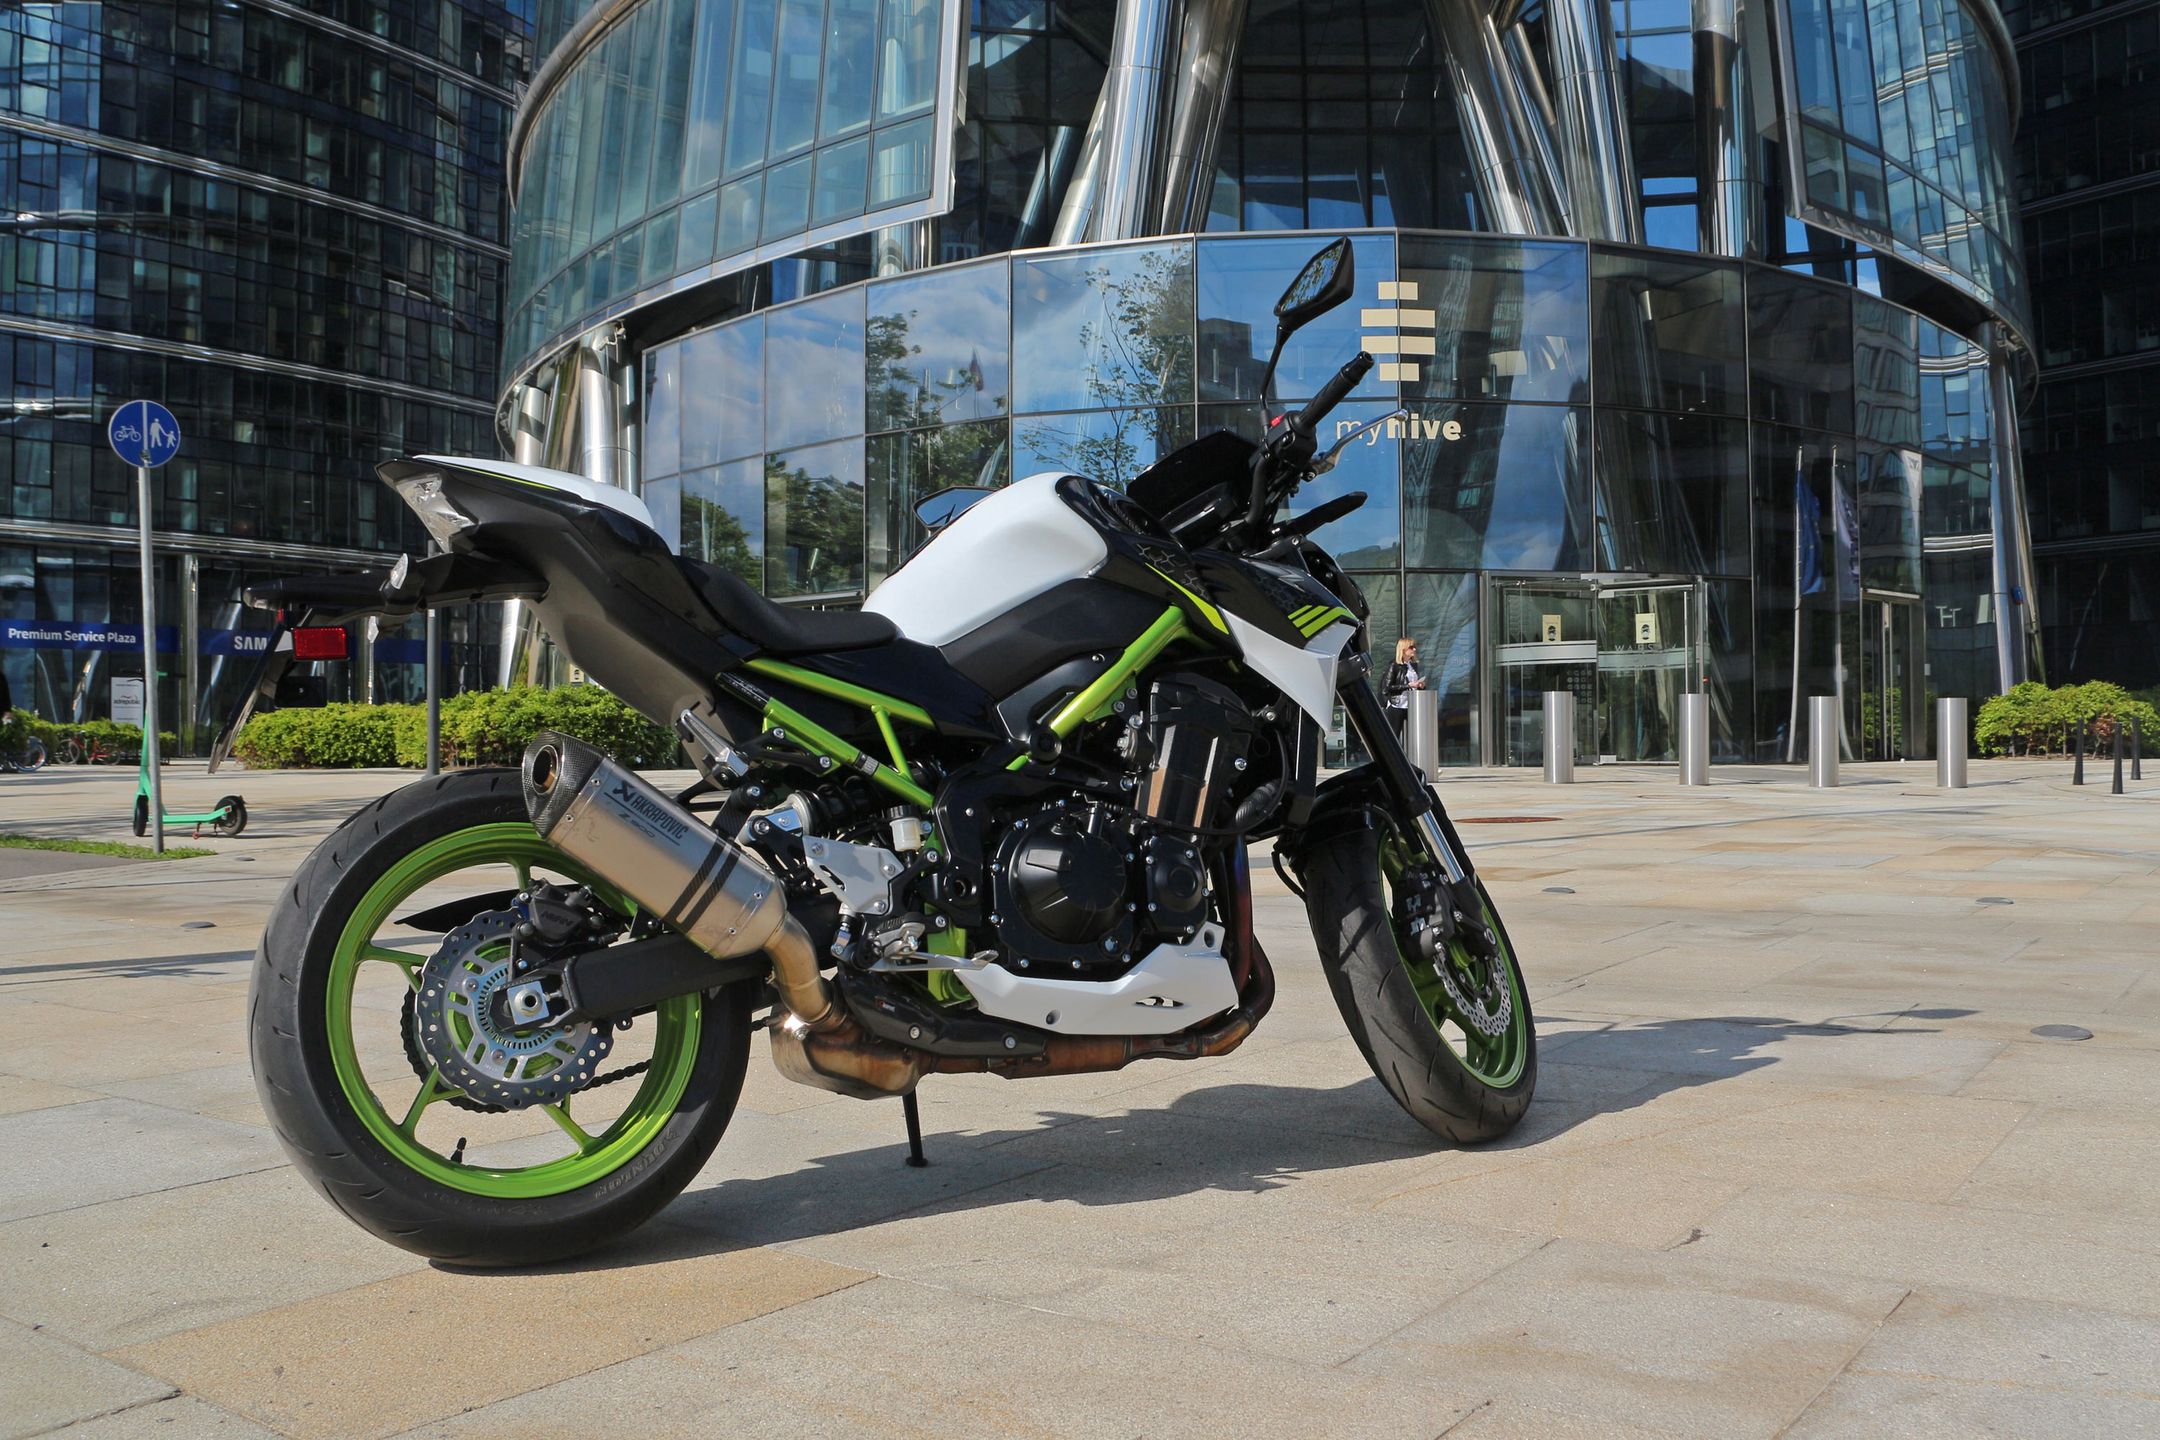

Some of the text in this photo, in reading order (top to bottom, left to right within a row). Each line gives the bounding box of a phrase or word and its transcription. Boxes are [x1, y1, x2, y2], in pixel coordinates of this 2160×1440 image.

[1336, 411, 1462, 446] myhive
[8, 627, 136, 643] Premium Service Plaza
[234, 635, 269, 650] SAM
